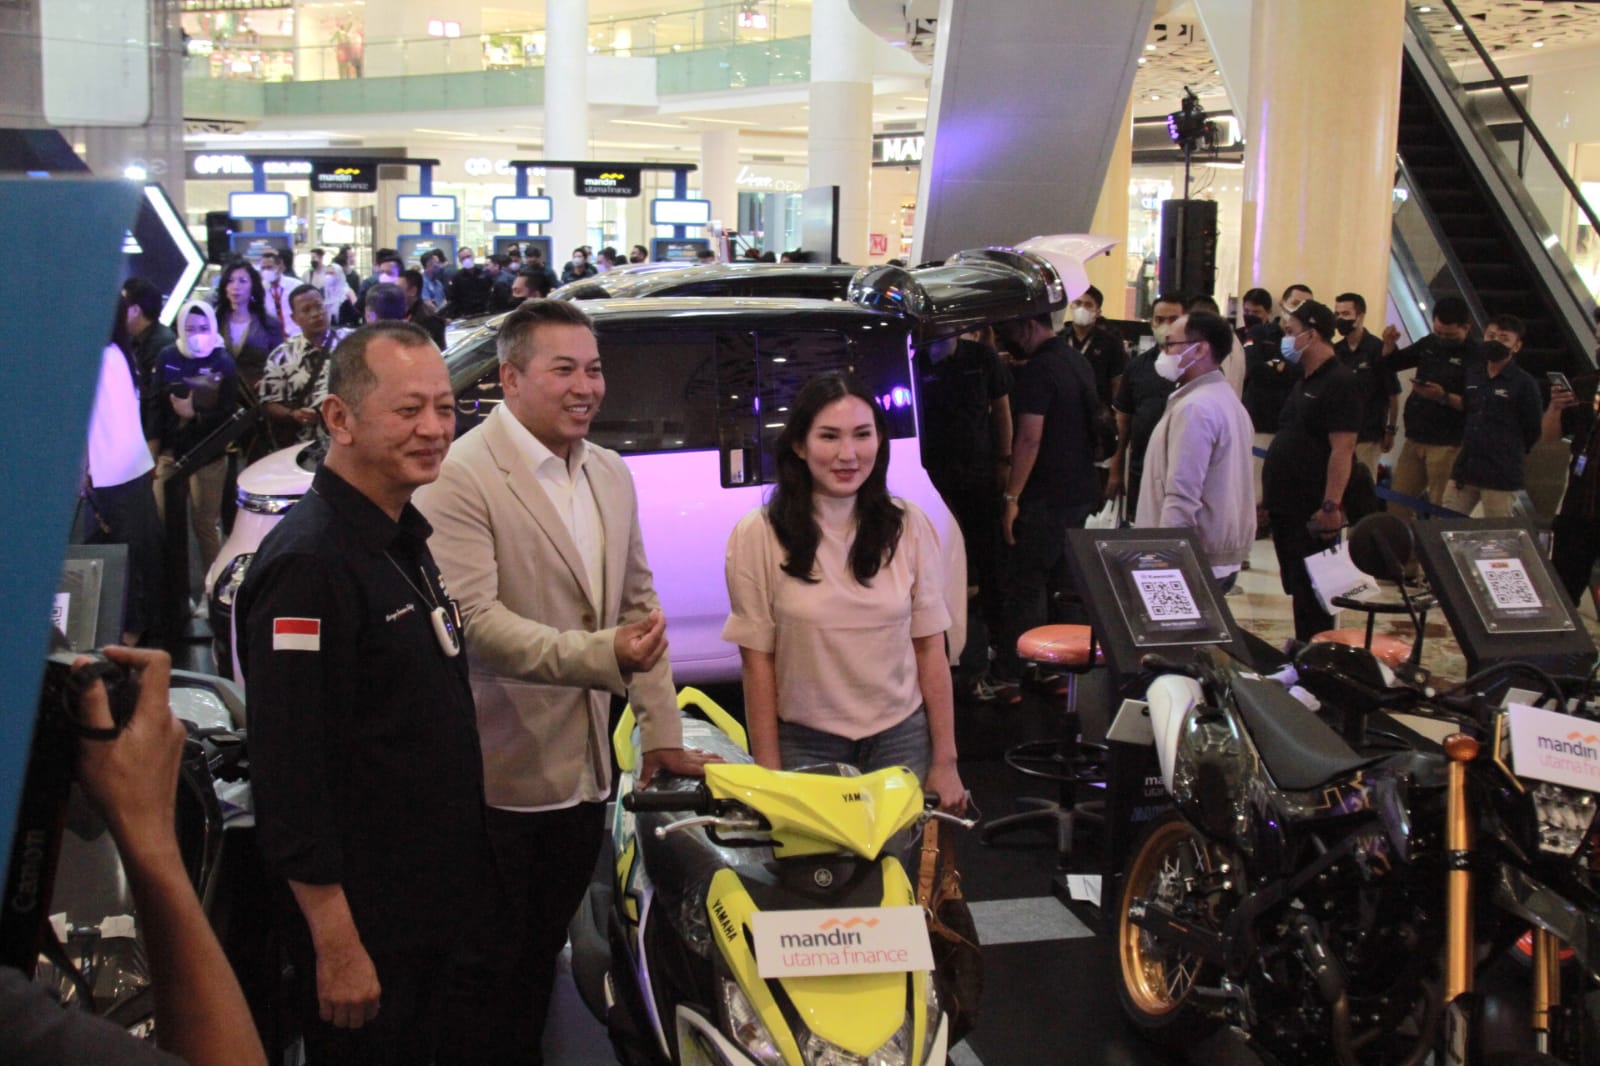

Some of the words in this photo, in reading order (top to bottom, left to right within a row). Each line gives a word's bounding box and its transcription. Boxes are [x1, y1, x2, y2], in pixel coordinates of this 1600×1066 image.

[1538, 736, 1597, 760] mandiri
[711, 899, 738, 942] YAMAHA
[780, 928, 862, 948] mandiri
[783, 952, 839, 968] utama
[842, 947, 909, 965] finance
